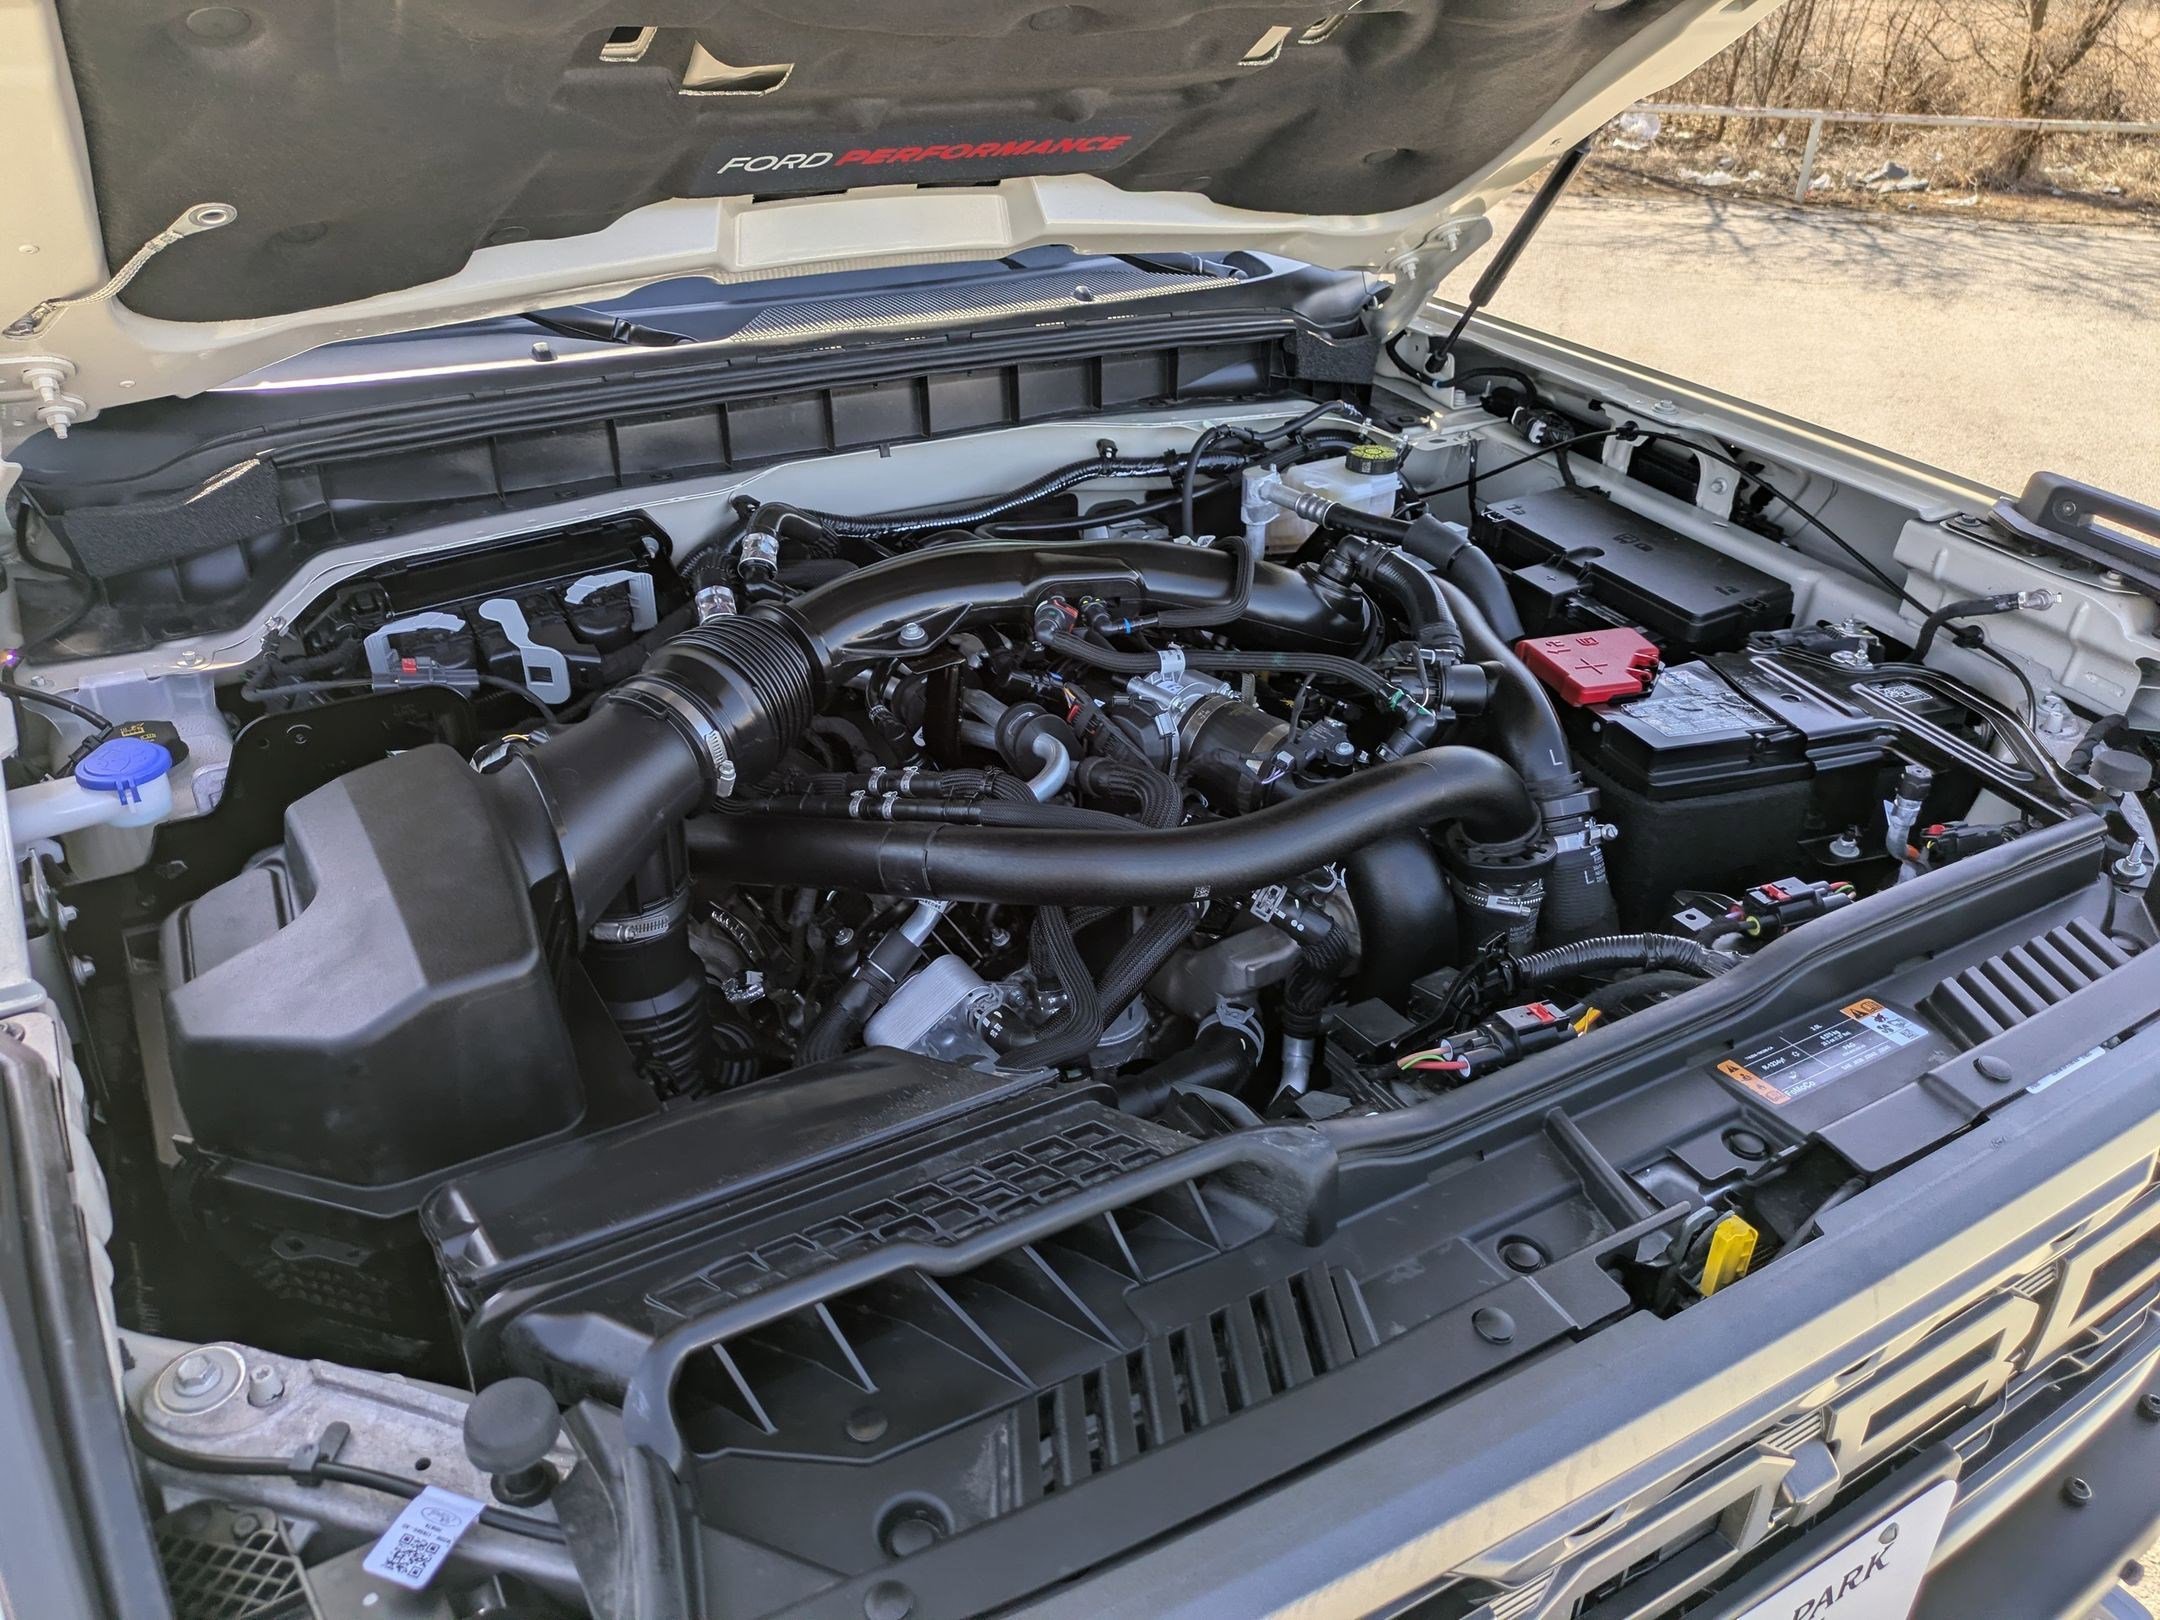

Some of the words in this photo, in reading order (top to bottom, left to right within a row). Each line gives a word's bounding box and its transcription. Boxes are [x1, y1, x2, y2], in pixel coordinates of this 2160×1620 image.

[717, 151, 833, 175] FORD
[836, 135, 1132, 167] PERFORMANCE
[1792, 1542, 1895, 1620] PARK
